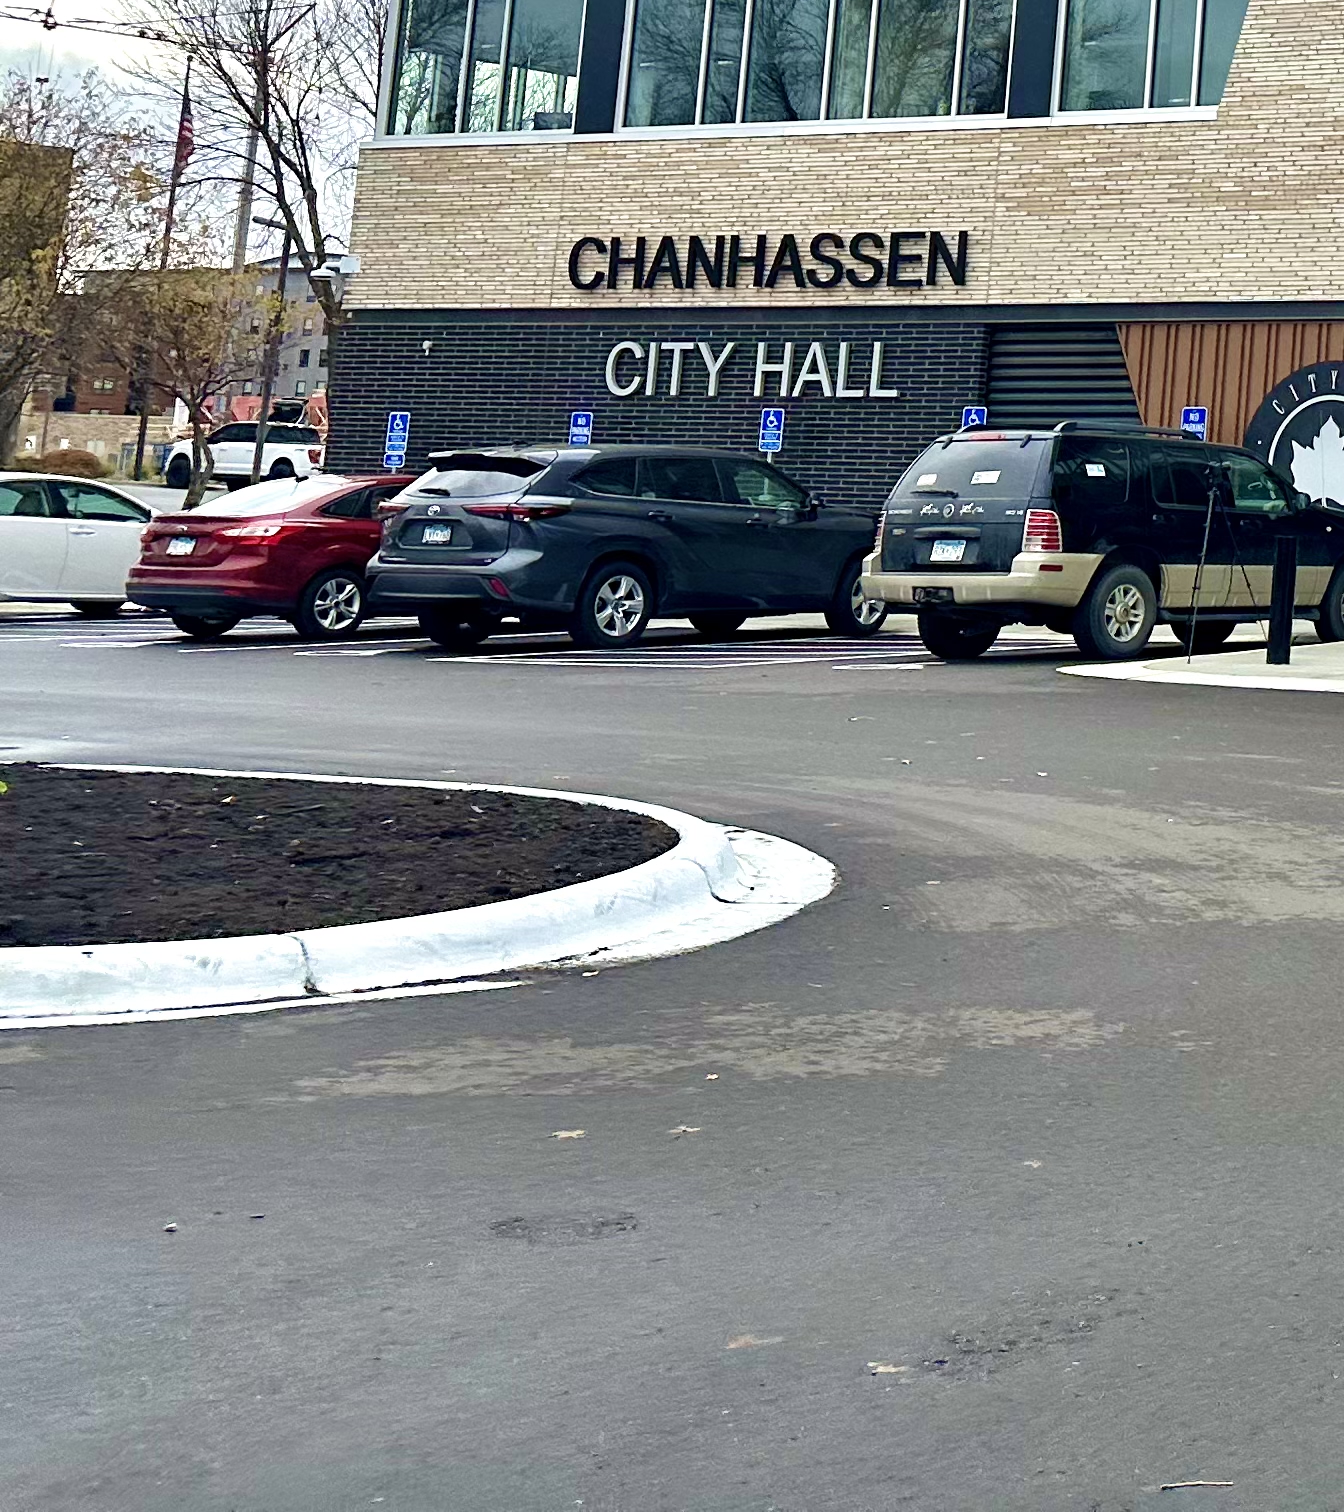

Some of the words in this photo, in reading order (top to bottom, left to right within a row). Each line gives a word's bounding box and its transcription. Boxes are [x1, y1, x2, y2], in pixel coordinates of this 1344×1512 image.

[568, 231, 968, 289] CHANHASSEN
[605, 340, 735, 398] CITY
[753, 341, 898, 399] HALL
[1272, 370, 1338, 414] CITY
